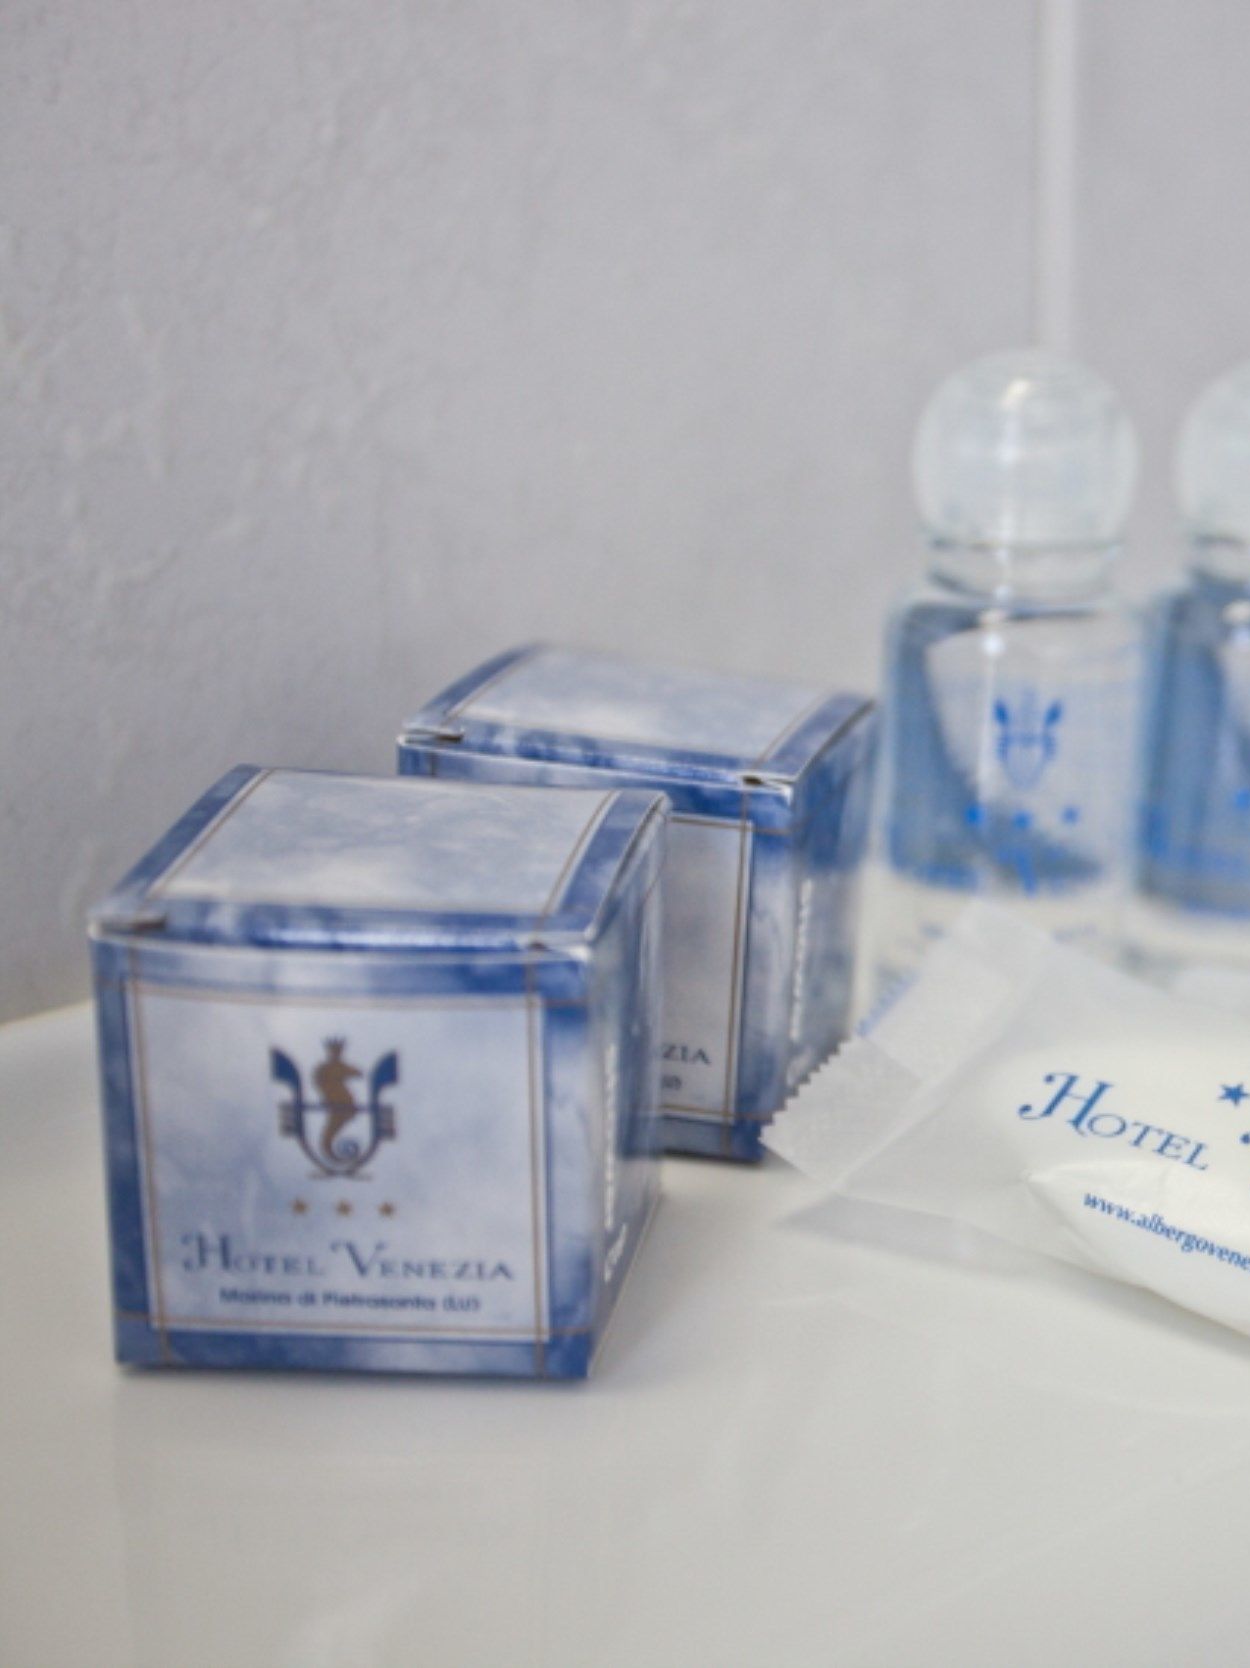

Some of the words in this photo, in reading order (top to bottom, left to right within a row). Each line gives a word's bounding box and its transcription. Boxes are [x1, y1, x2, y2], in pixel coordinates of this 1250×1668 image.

[1017, 1072, 1210, 1171] HOTEL
[181, 1231, 325, 1275] HOTEL
[330, 1238, 514, 1281] VENEZIA
